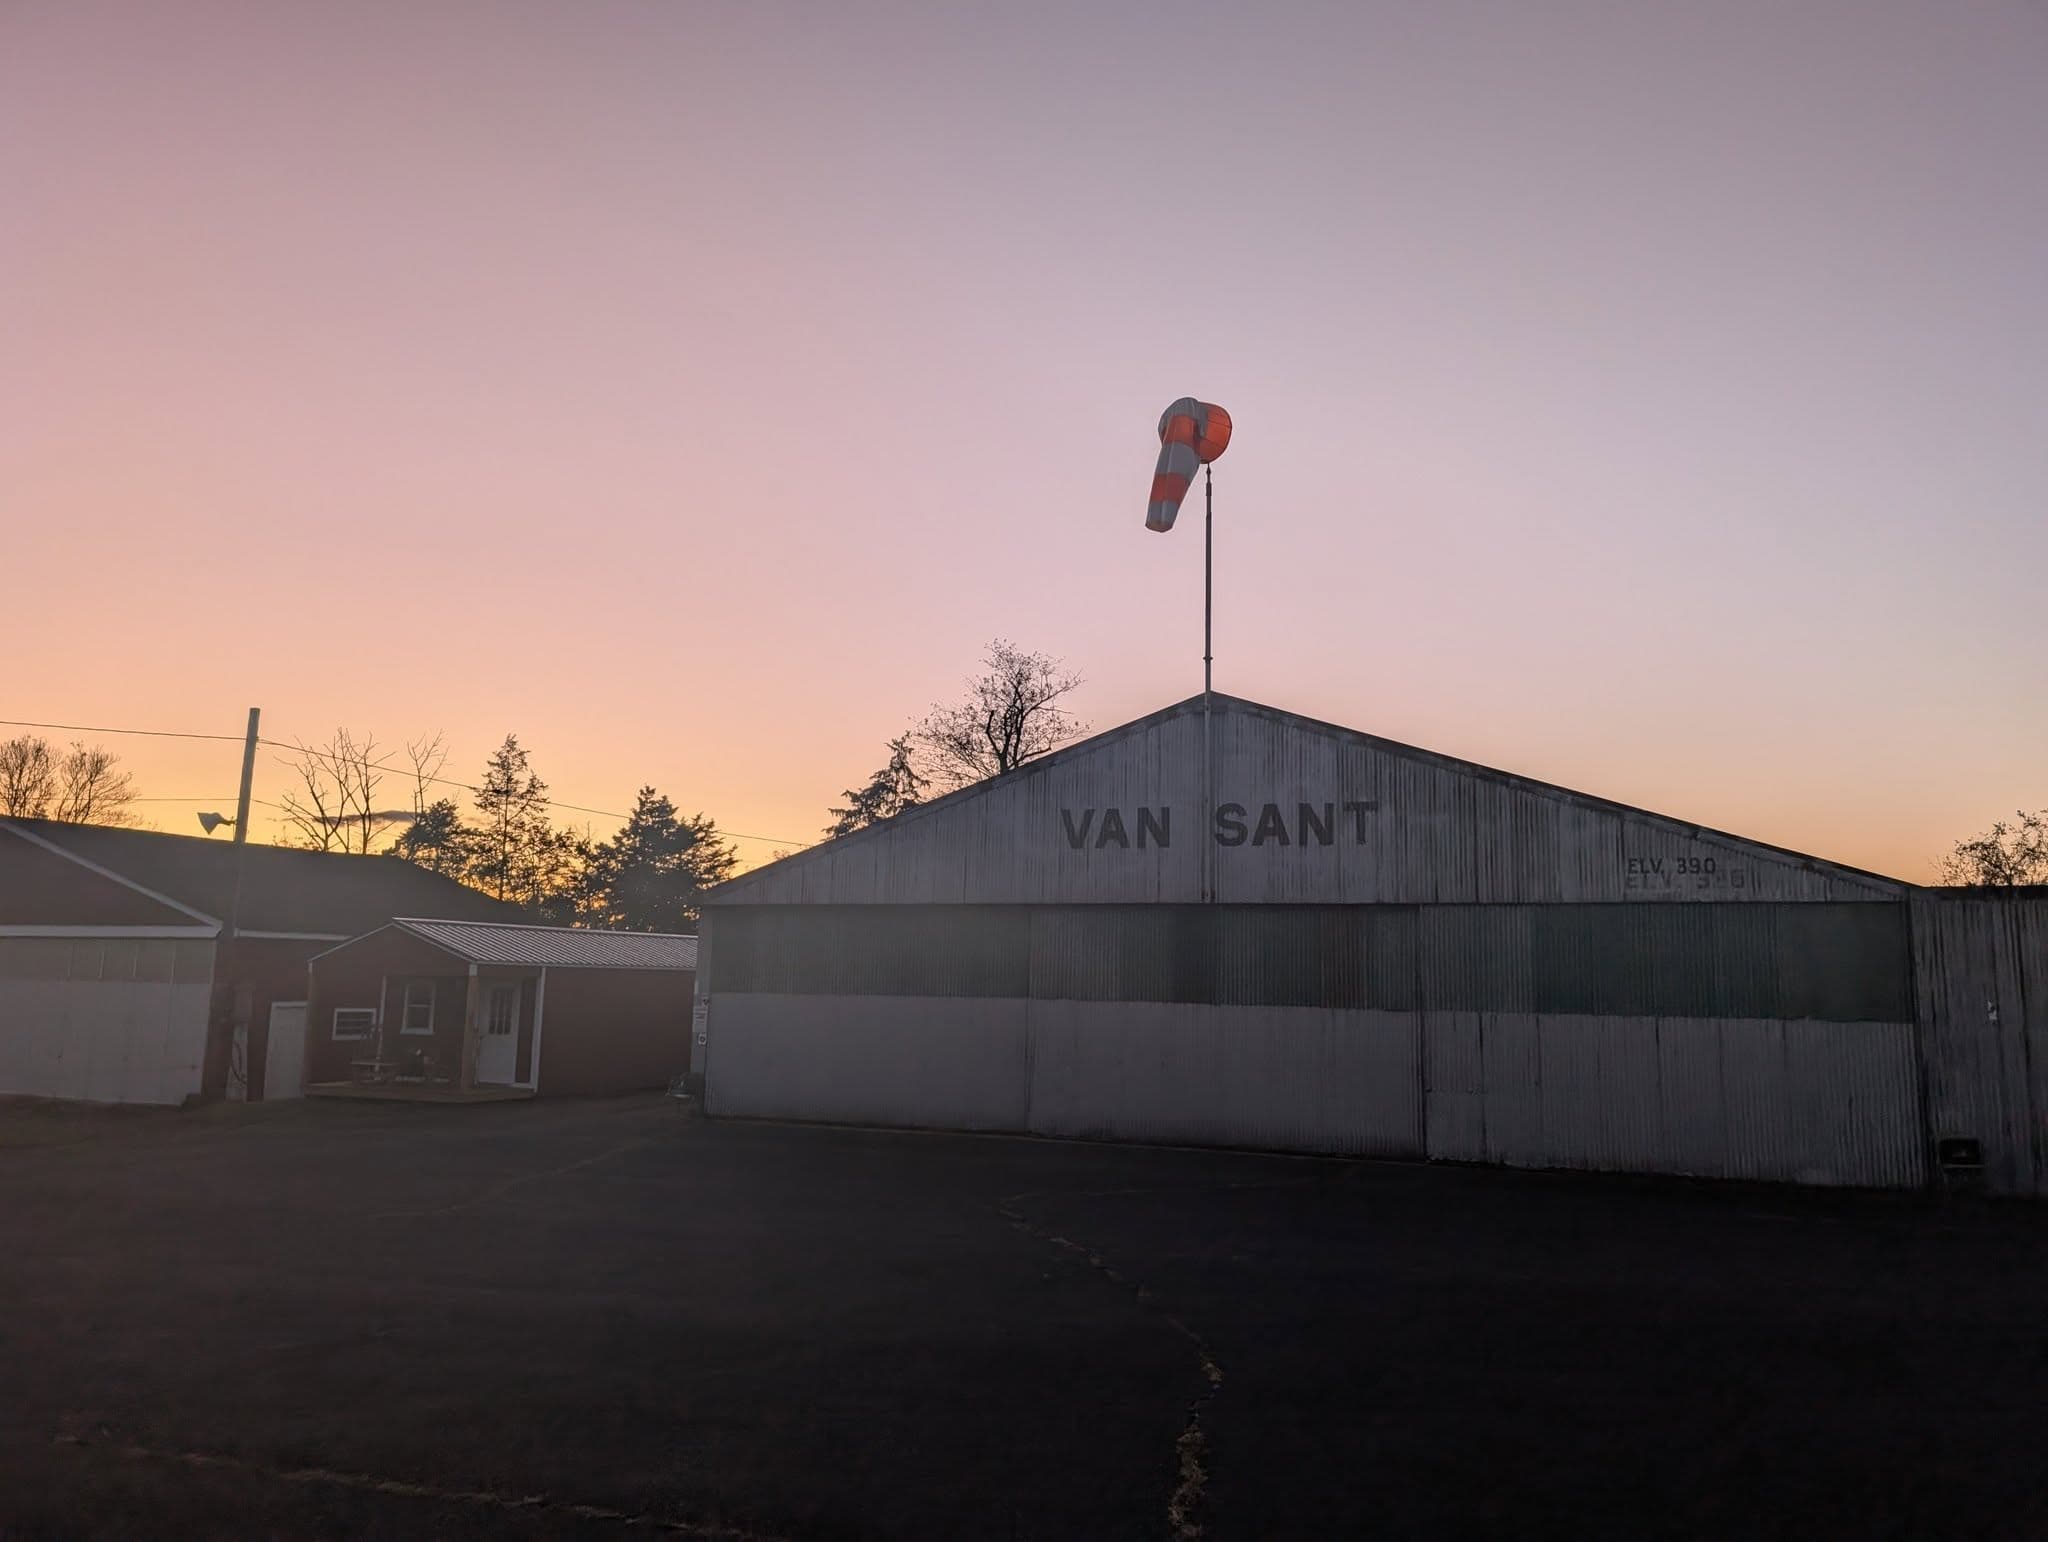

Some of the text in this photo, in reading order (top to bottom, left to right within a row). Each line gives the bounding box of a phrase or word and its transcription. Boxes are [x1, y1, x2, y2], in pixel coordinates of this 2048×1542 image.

[1061, 801, 1379, 849] VAN SANT
[1677, 858, 1716, 875] 390
